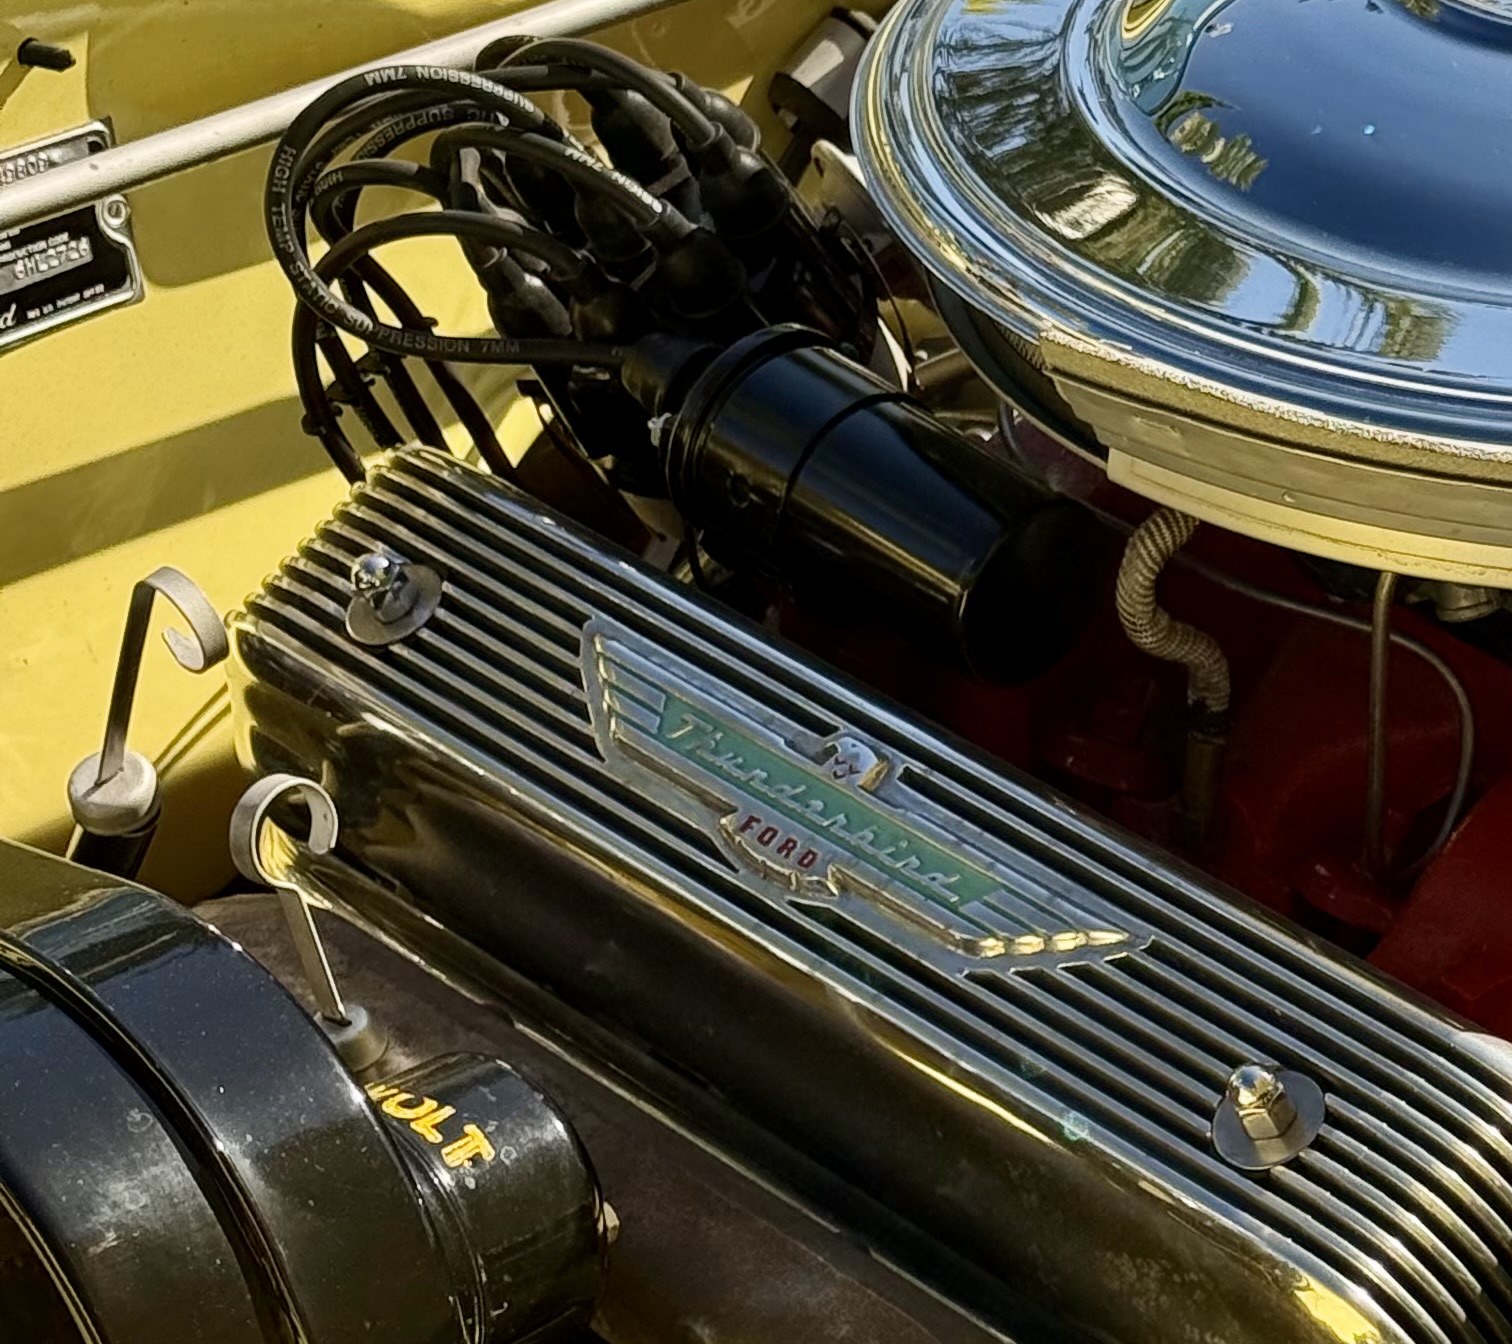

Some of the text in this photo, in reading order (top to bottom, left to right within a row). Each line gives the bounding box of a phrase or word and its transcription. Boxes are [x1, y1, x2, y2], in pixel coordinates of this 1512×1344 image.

[363, 66, 409, 86] 7MM
[272, 146, 297, 200] HIGH
[270, 201, 297, 262] TEMP
[289, 261, 341, 317] STATIC
[343, 310, 472, 355] SUPPRESSION
[480, 338, 521, 355] 7MM
[665, 712, 961, 904] Thunderbird
[738, 813, 820, 870] FORD
